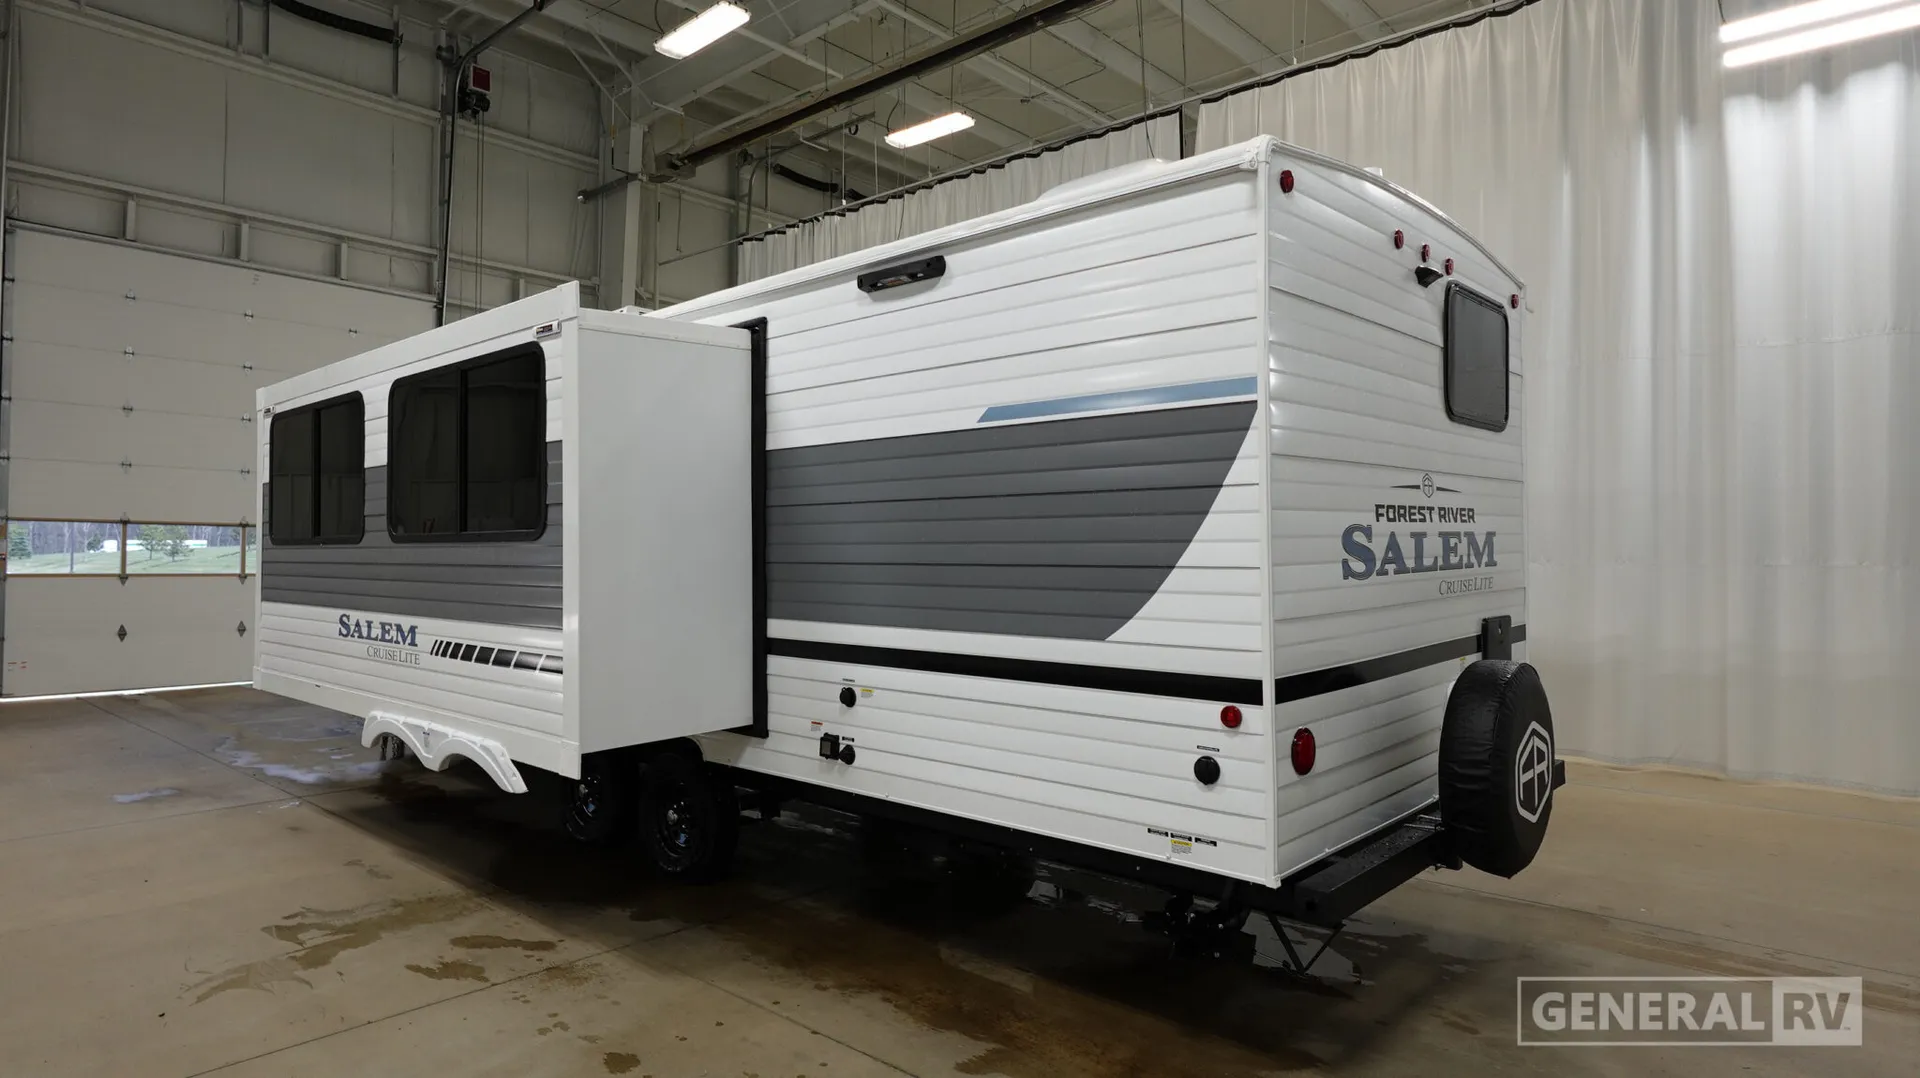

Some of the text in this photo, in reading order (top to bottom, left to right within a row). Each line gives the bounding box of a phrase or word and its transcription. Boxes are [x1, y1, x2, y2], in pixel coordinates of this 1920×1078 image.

[1374, 503, 1476, 524] FOREST RIVER
[1341, 523, 1498, 581] SALEM
[338, 613, 419, 648] SALEM
